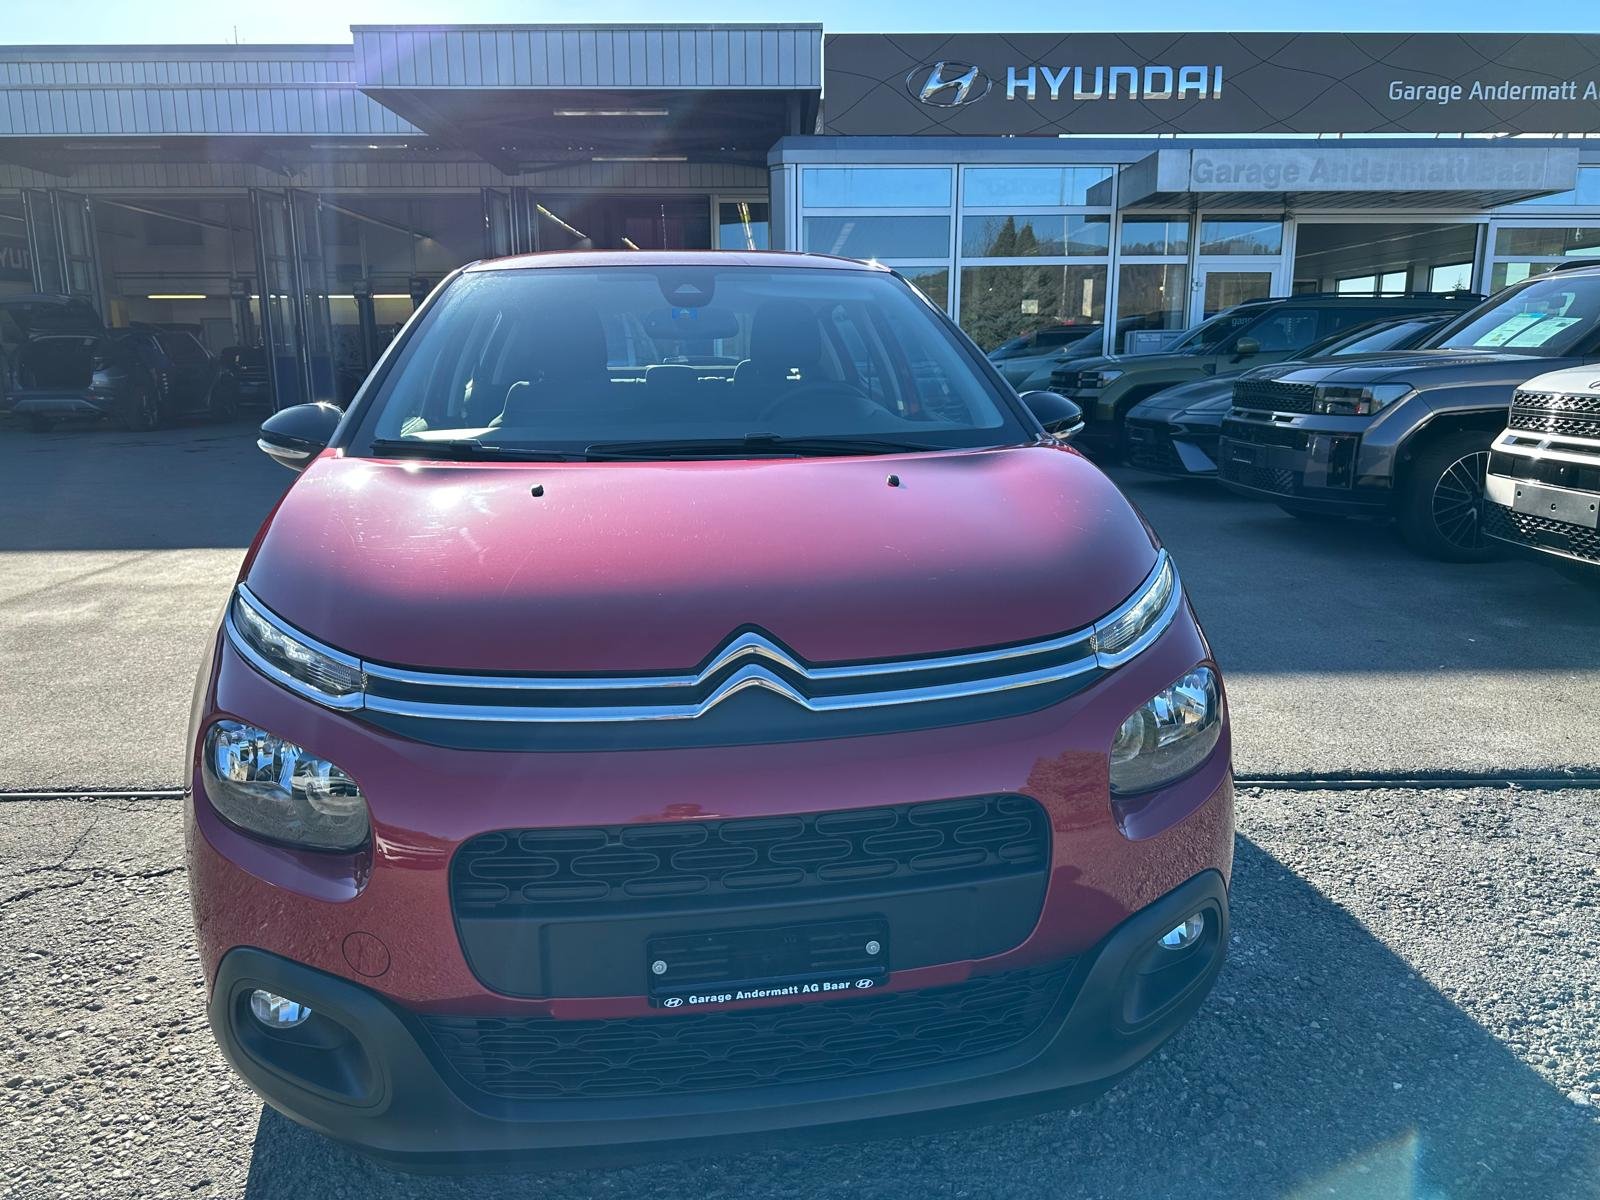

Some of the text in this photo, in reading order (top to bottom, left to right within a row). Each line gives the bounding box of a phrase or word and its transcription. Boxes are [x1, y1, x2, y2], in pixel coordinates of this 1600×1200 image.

[1006, 65, 1223, 100] HYUNDAI
[1388, 80, 1600, 105] Garage Andermatt A
[1193, 157, 1300, 190] Garage
[688, 980, 851, 1004] Garage Andermatt AG Baar
